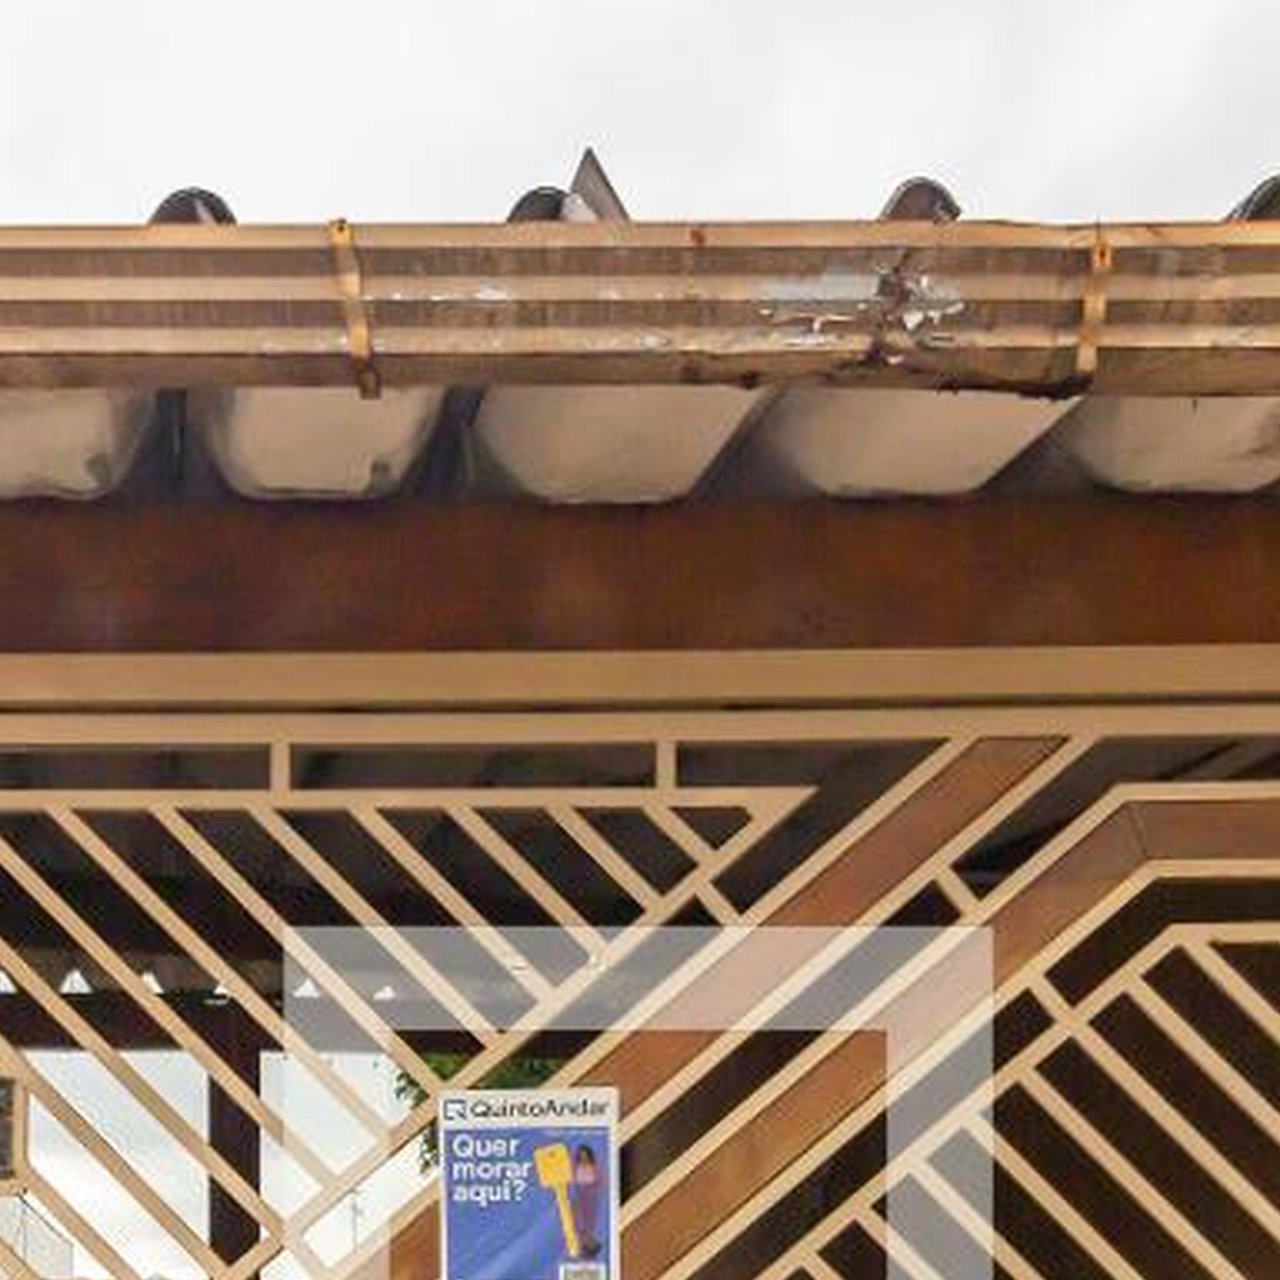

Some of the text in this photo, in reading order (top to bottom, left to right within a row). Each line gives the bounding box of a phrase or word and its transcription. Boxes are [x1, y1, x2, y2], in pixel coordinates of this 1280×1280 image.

[471, 1099, 609, 1118] QuintoAndar
[452, 1134, 520, 1159] Quer
[452, 1161, 532, 1181] morar
[452, 1180, 528, 1207] aqui?
